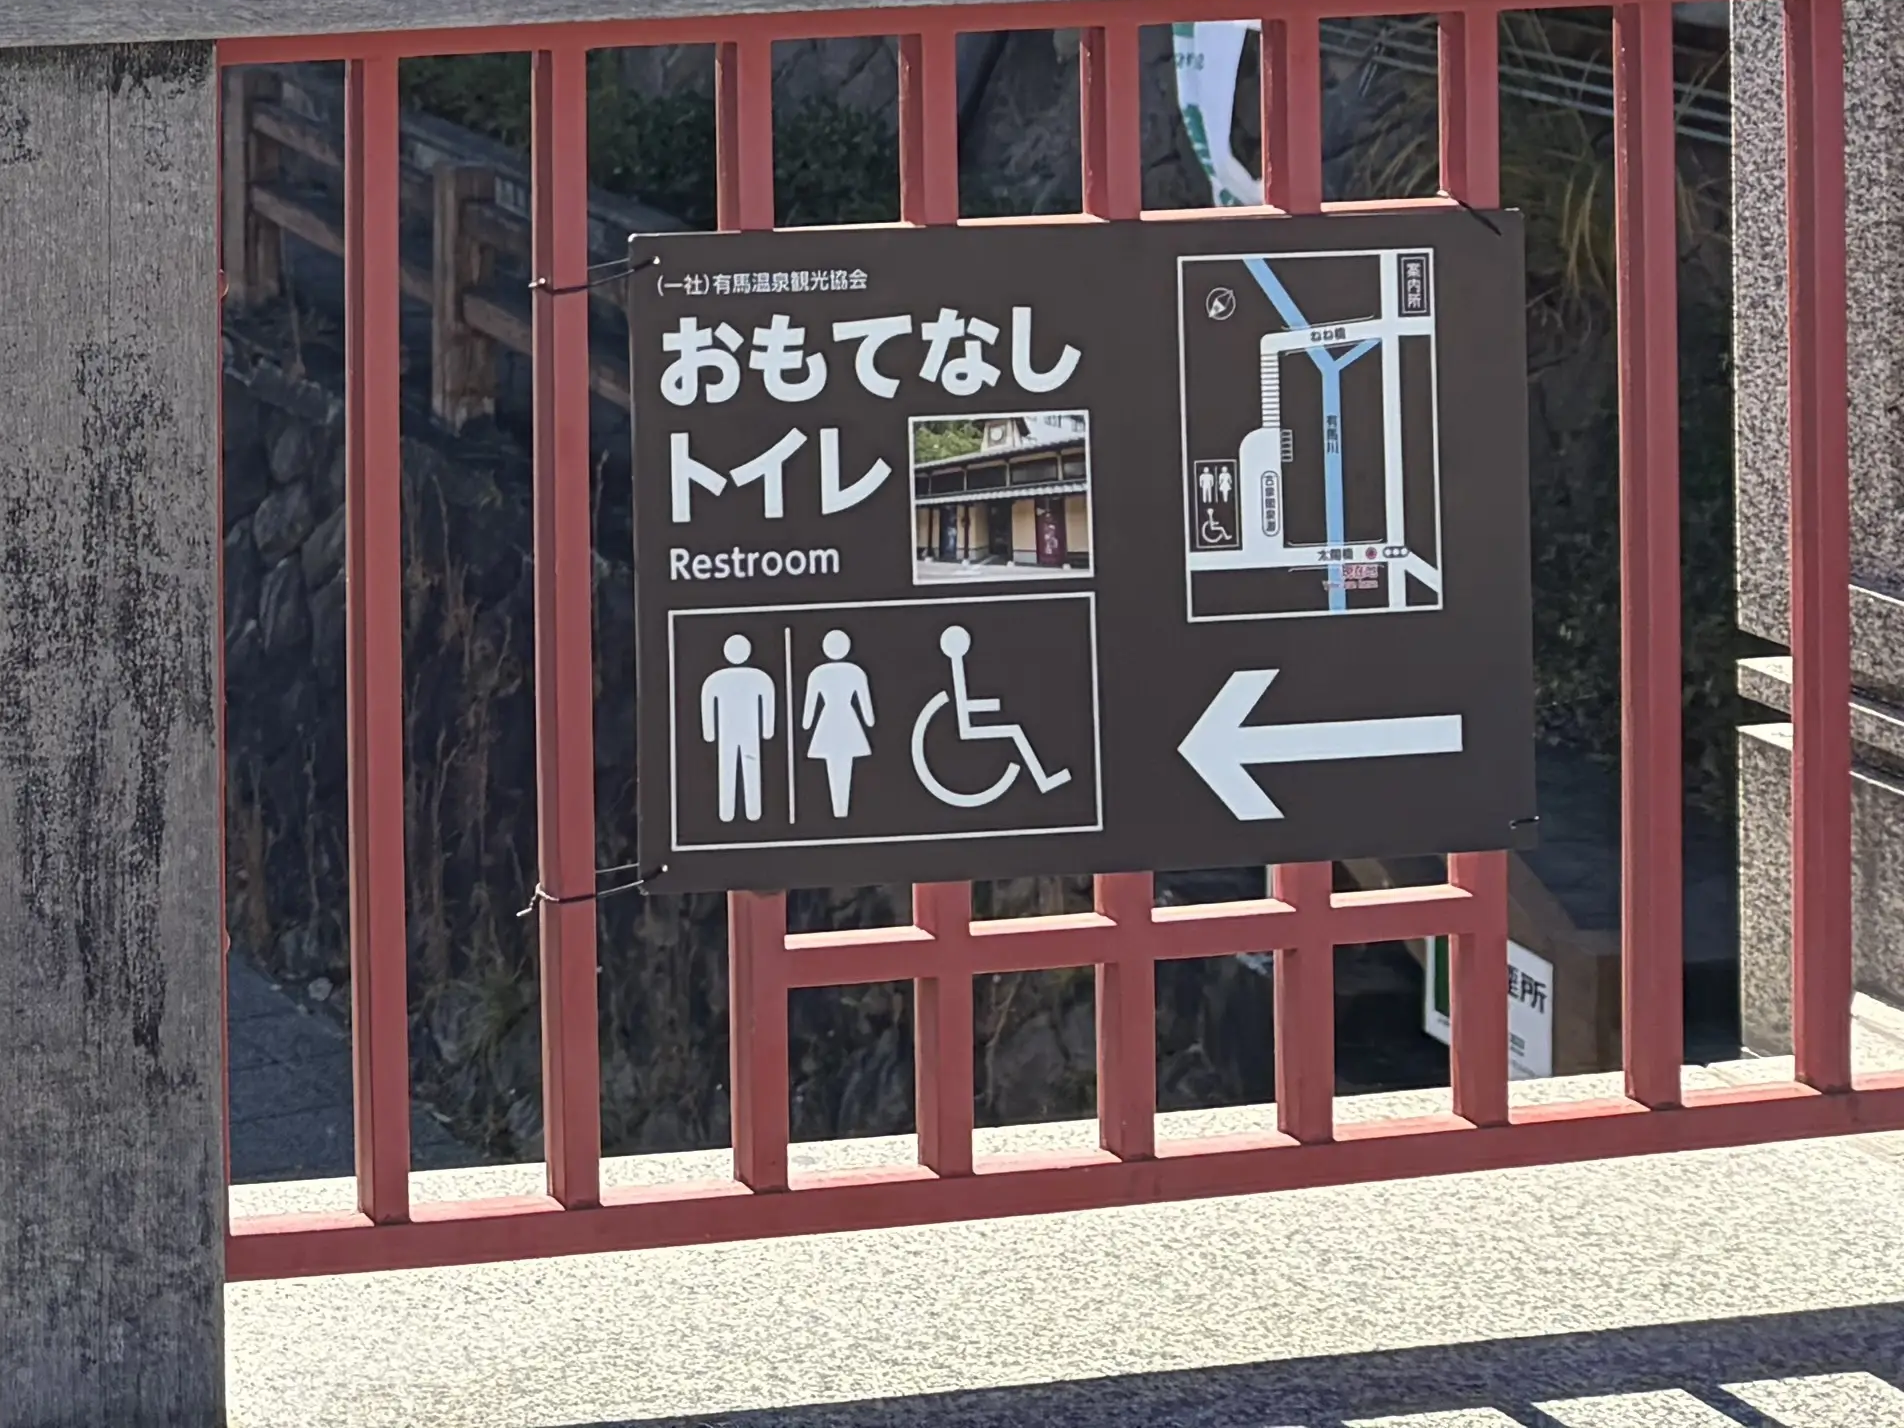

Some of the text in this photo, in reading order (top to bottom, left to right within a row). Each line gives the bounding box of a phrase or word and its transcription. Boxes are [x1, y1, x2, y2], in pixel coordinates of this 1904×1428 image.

[660, 306, 1082, 406] おもてなし
[670, 427, 892, 523] トイレ
[670, 546, 840, 581] Restroom
